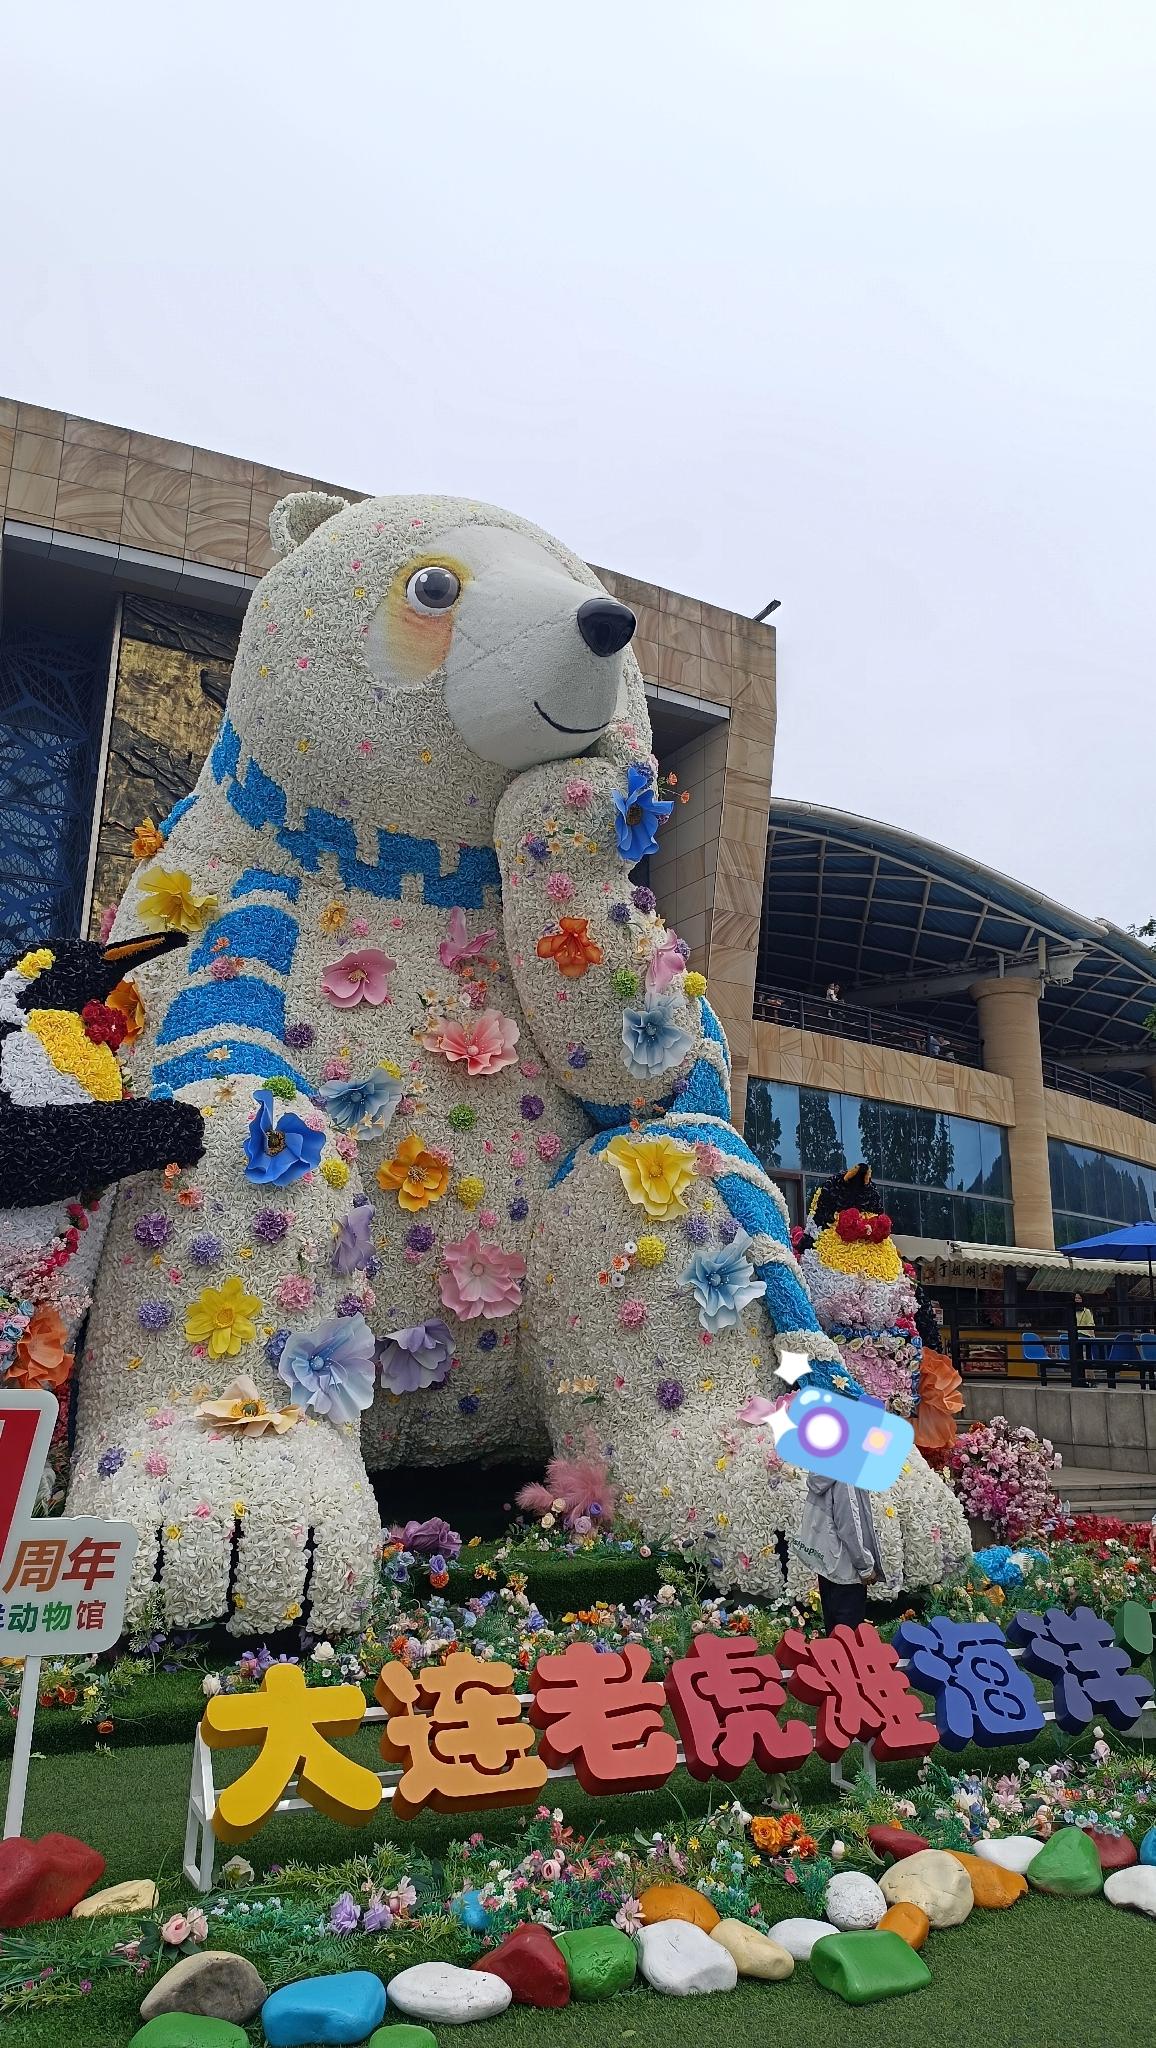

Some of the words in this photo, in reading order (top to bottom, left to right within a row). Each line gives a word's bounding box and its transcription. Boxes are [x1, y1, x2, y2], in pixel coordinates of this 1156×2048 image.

[2, 1537, 121, 1594] 周年
[0, 1600, 107, 1633] 动物馆
[200, 1600, 1156, 1844] 大连老虎滩海洋
